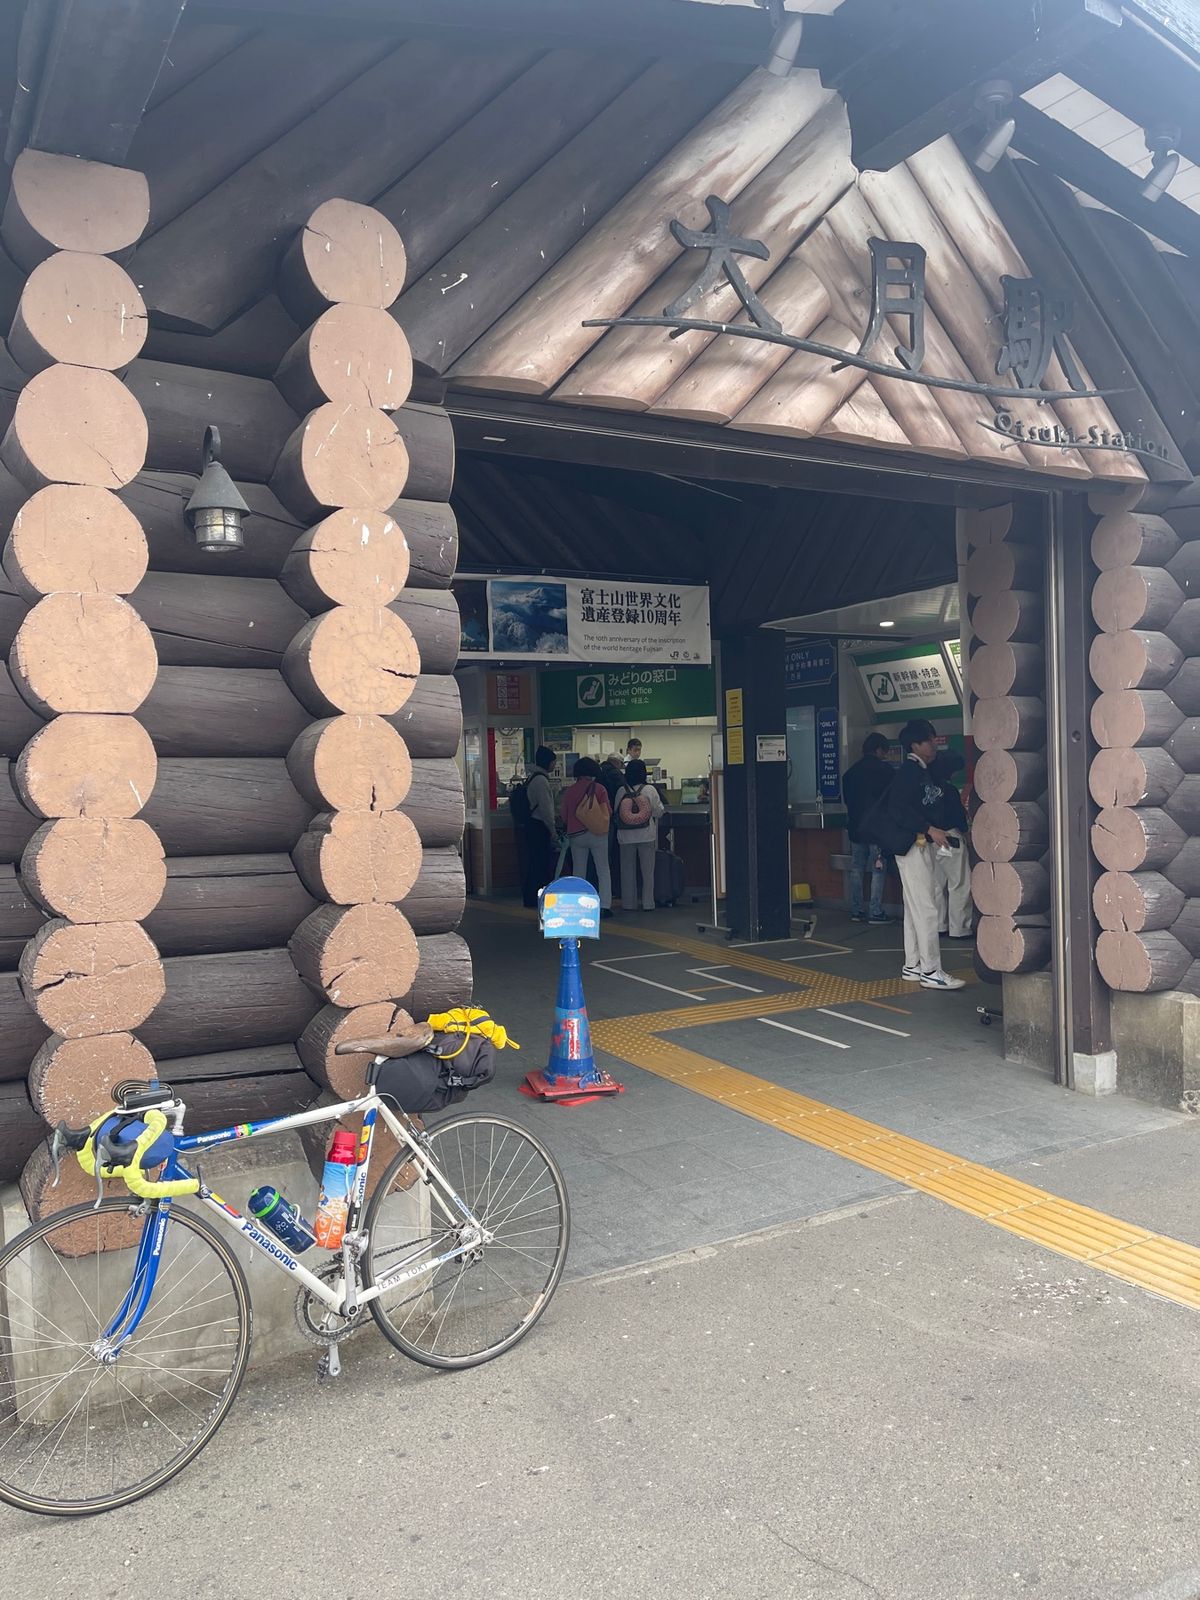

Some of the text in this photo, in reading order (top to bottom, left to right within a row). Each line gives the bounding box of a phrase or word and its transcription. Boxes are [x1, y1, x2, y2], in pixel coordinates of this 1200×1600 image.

[663, 194, 1087, 391] 大月駅
[580, 588, 681, 609] 富士山世界文化
[581, 606, 682, 626] 遺産登録10周年
[591, 644, 601, 652] the
[608, 636, 641, 645] anniversary
[648, 636, 658, 644] the
[669, 651, 680, 660] JR
[608, 669, 677, 686] みどりの窓口
[608, 686, 653, 697] Ticket Office
[197, 1131, 232, 1144] Panasonic
[357, 1171, 367, 1205] sonic
[153, 1217, 167, 1256] Panasonic
[242, 1222, 298, 1271] Panasonic
